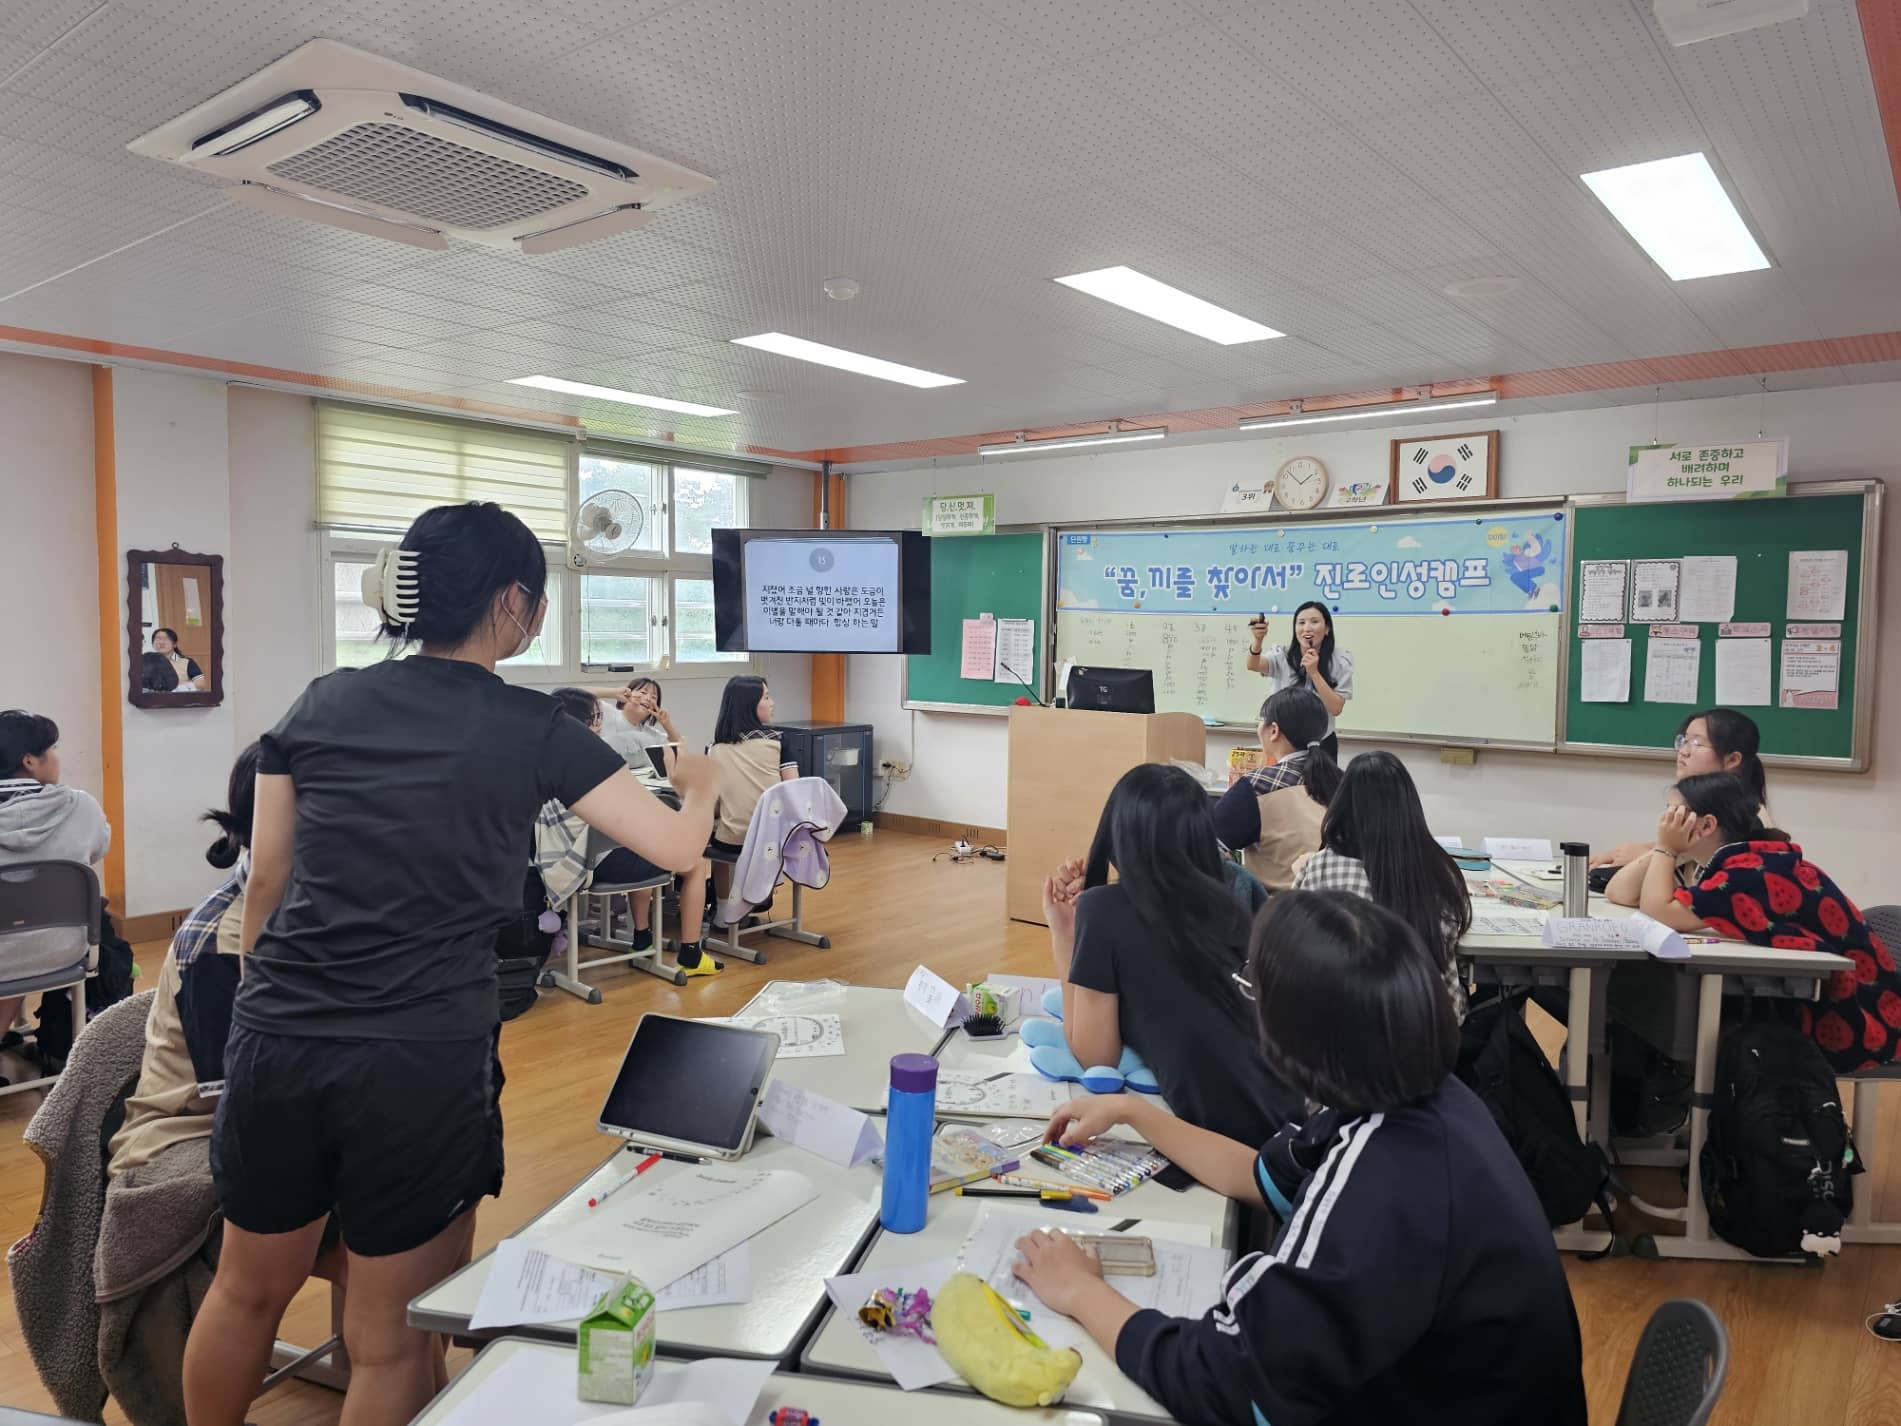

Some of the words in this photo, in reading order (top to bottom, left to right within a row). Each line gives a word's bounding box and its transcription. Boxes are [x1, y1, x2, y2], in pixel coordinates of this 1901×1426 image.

[1669, 450, 1693, 462] 서로
[1699, 447, 1745, 462] 존중하고
[1681, 461, 1730, 474] 배려하며
[1666, 476, 1713, 488] 하나되는
[1719, 474, 1744, 486] 우리
[1207, 563, 1303, 601] 찾아서”
[1313, 557, 1491, 600] 진로인성캠프
[861, 586, 884, 597] 도금이
[785, 596, 817, 607] 반지처럼
[863, 597, 887, 607] 오늘은
[805, 618, 829, 628] 때마다
[853, 618, 869, 629] 하는
